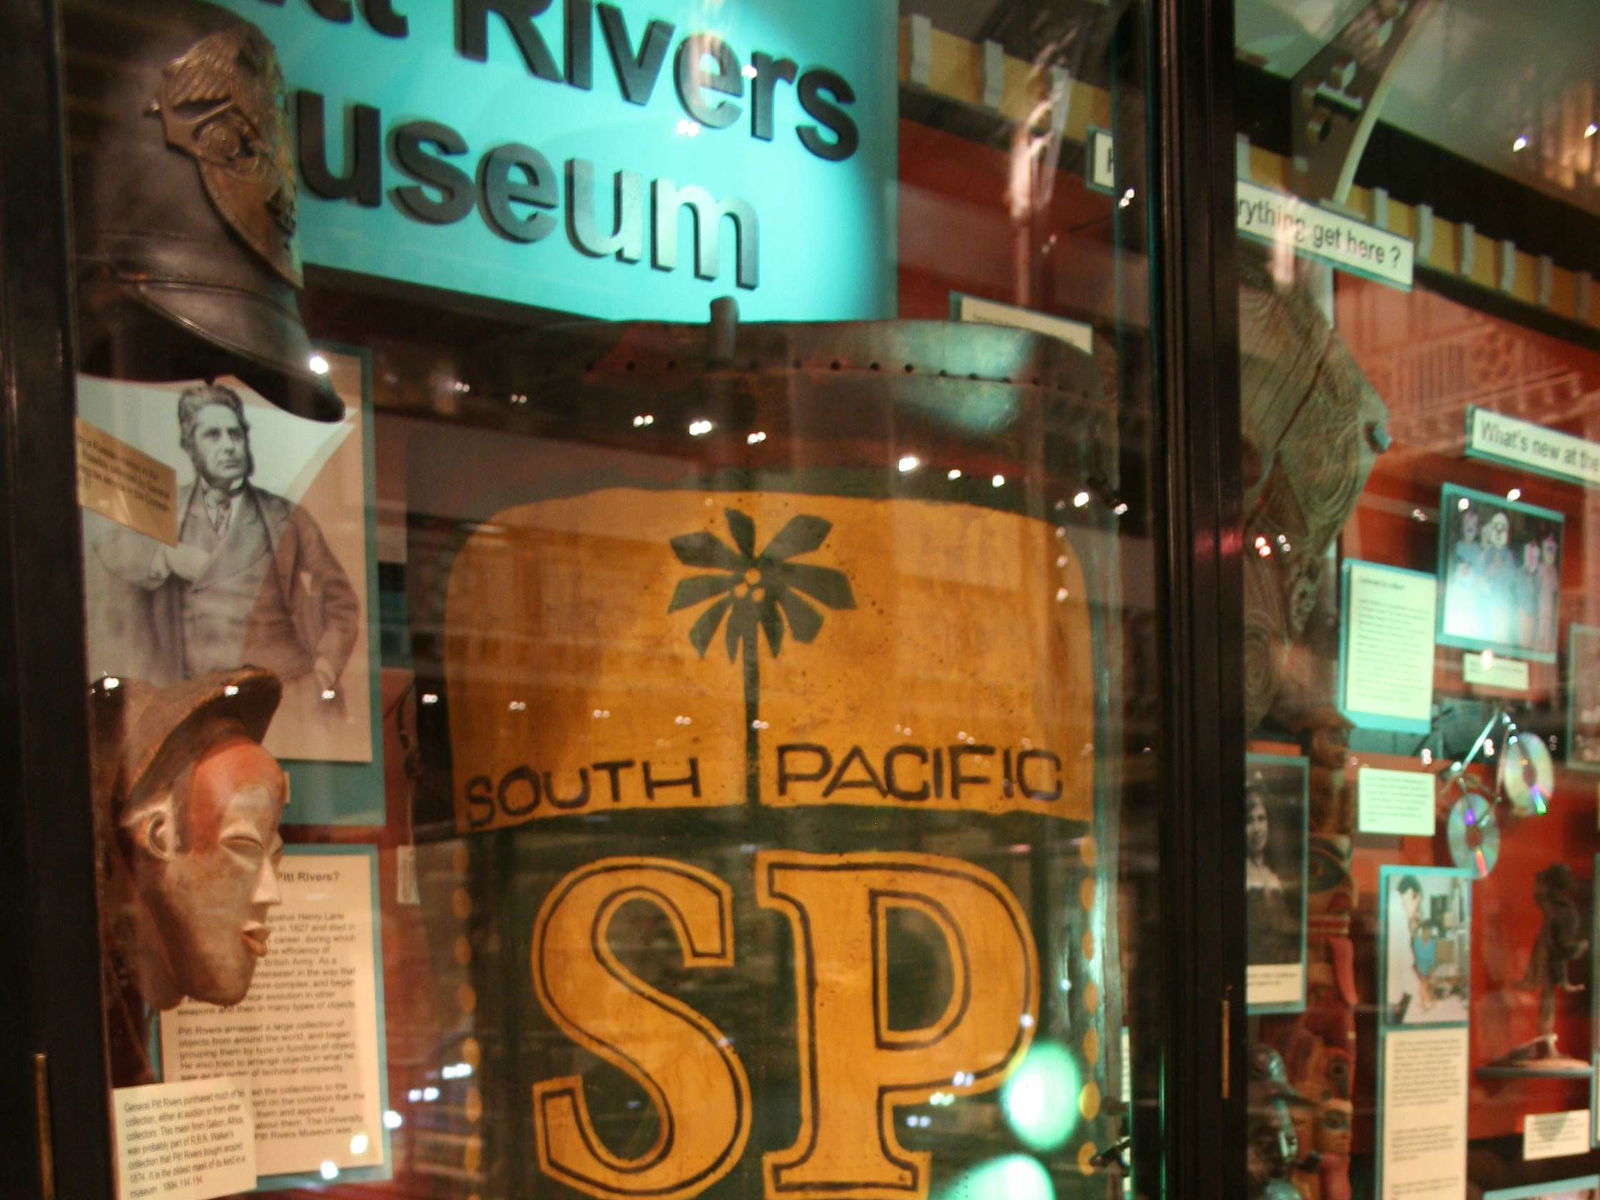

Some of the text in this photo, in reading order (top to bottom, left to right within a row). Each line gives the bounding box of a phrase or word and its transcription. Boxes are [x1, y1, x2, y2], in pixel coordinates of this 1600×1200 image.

[296, 88, 760, 291] useum
[1313, 222, 1342, 249] get
[1346, 230, 1386, 265] here
[1481, 419, 1528, 452] What's
[1532, 439, 1560, 460] new
[466, 743, 1064, 831] SOUTH PACIFIC
